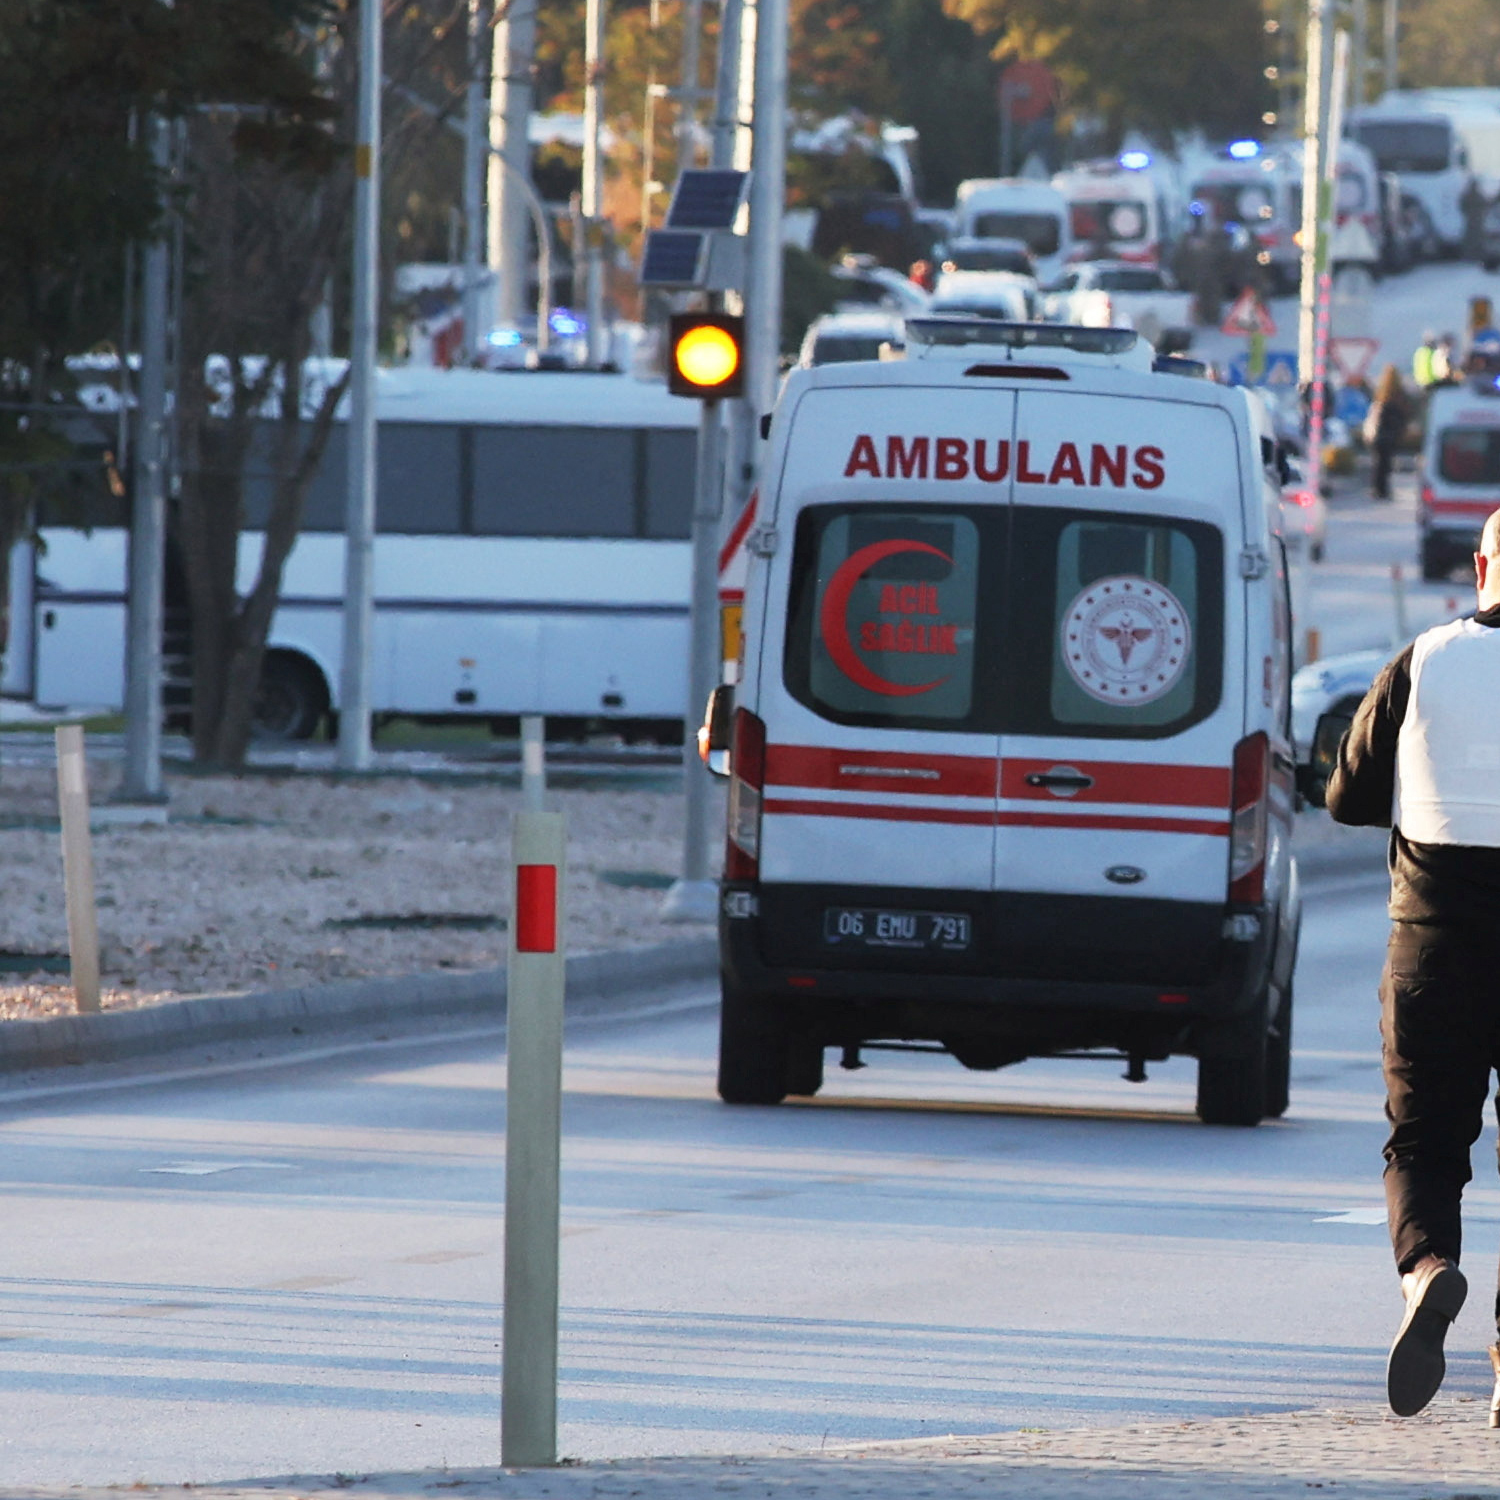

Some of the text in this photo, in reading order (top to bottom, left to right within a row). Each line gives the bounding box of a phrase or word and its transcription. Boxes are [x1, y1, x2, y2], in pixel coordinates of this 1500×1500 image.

[844, 434, 1165, 490] AMBULANS
[878, 580, 941, 615] ACİL
[860, 619, 958, 655] SAĞLIK
[838, 912, 967, 942] 06 EMU 791
